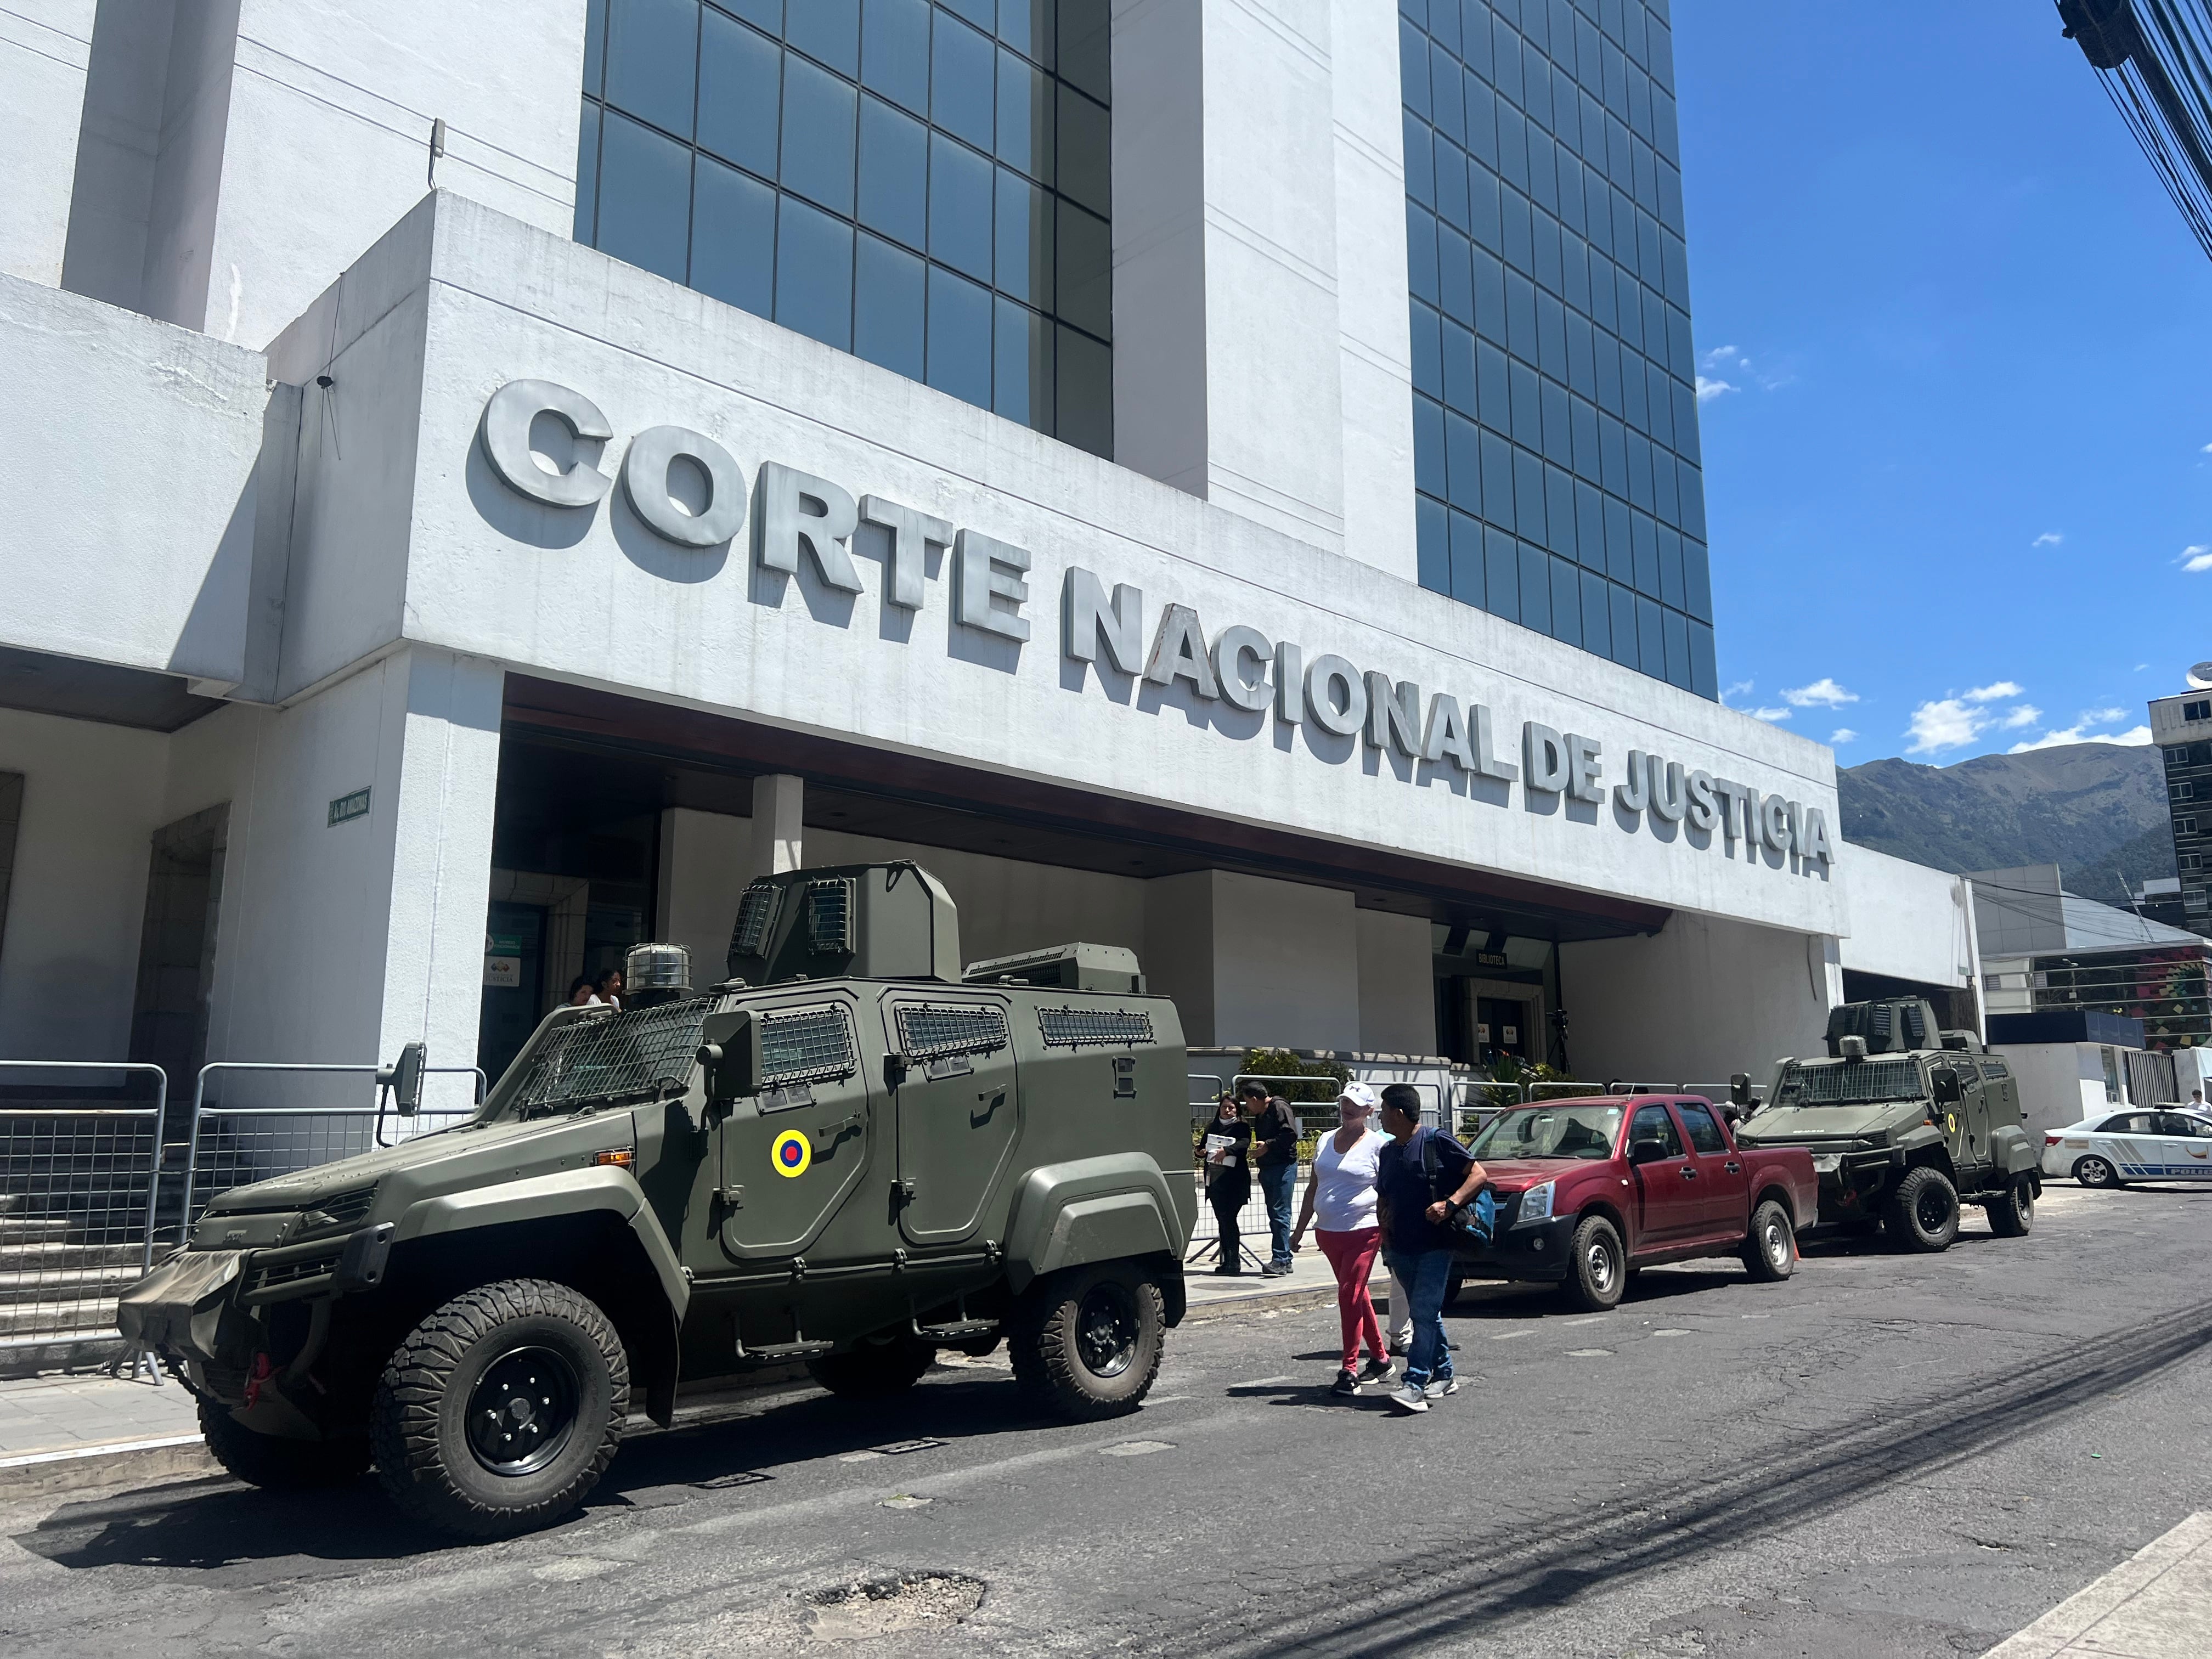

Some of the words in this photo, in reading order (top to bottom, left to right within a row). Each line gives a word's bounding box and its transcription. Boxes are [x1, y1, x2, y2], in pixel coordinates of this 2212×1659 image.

[480, 379, 1030, 643] CORTE
[1060, 566, 1519, 782] NACIONAL
[1523, 721, 1605, 804] DE
[1614, 750, 1835, 865] JUSTICIA
[1479, 953, 1505, 966] BIBLIOTECA
